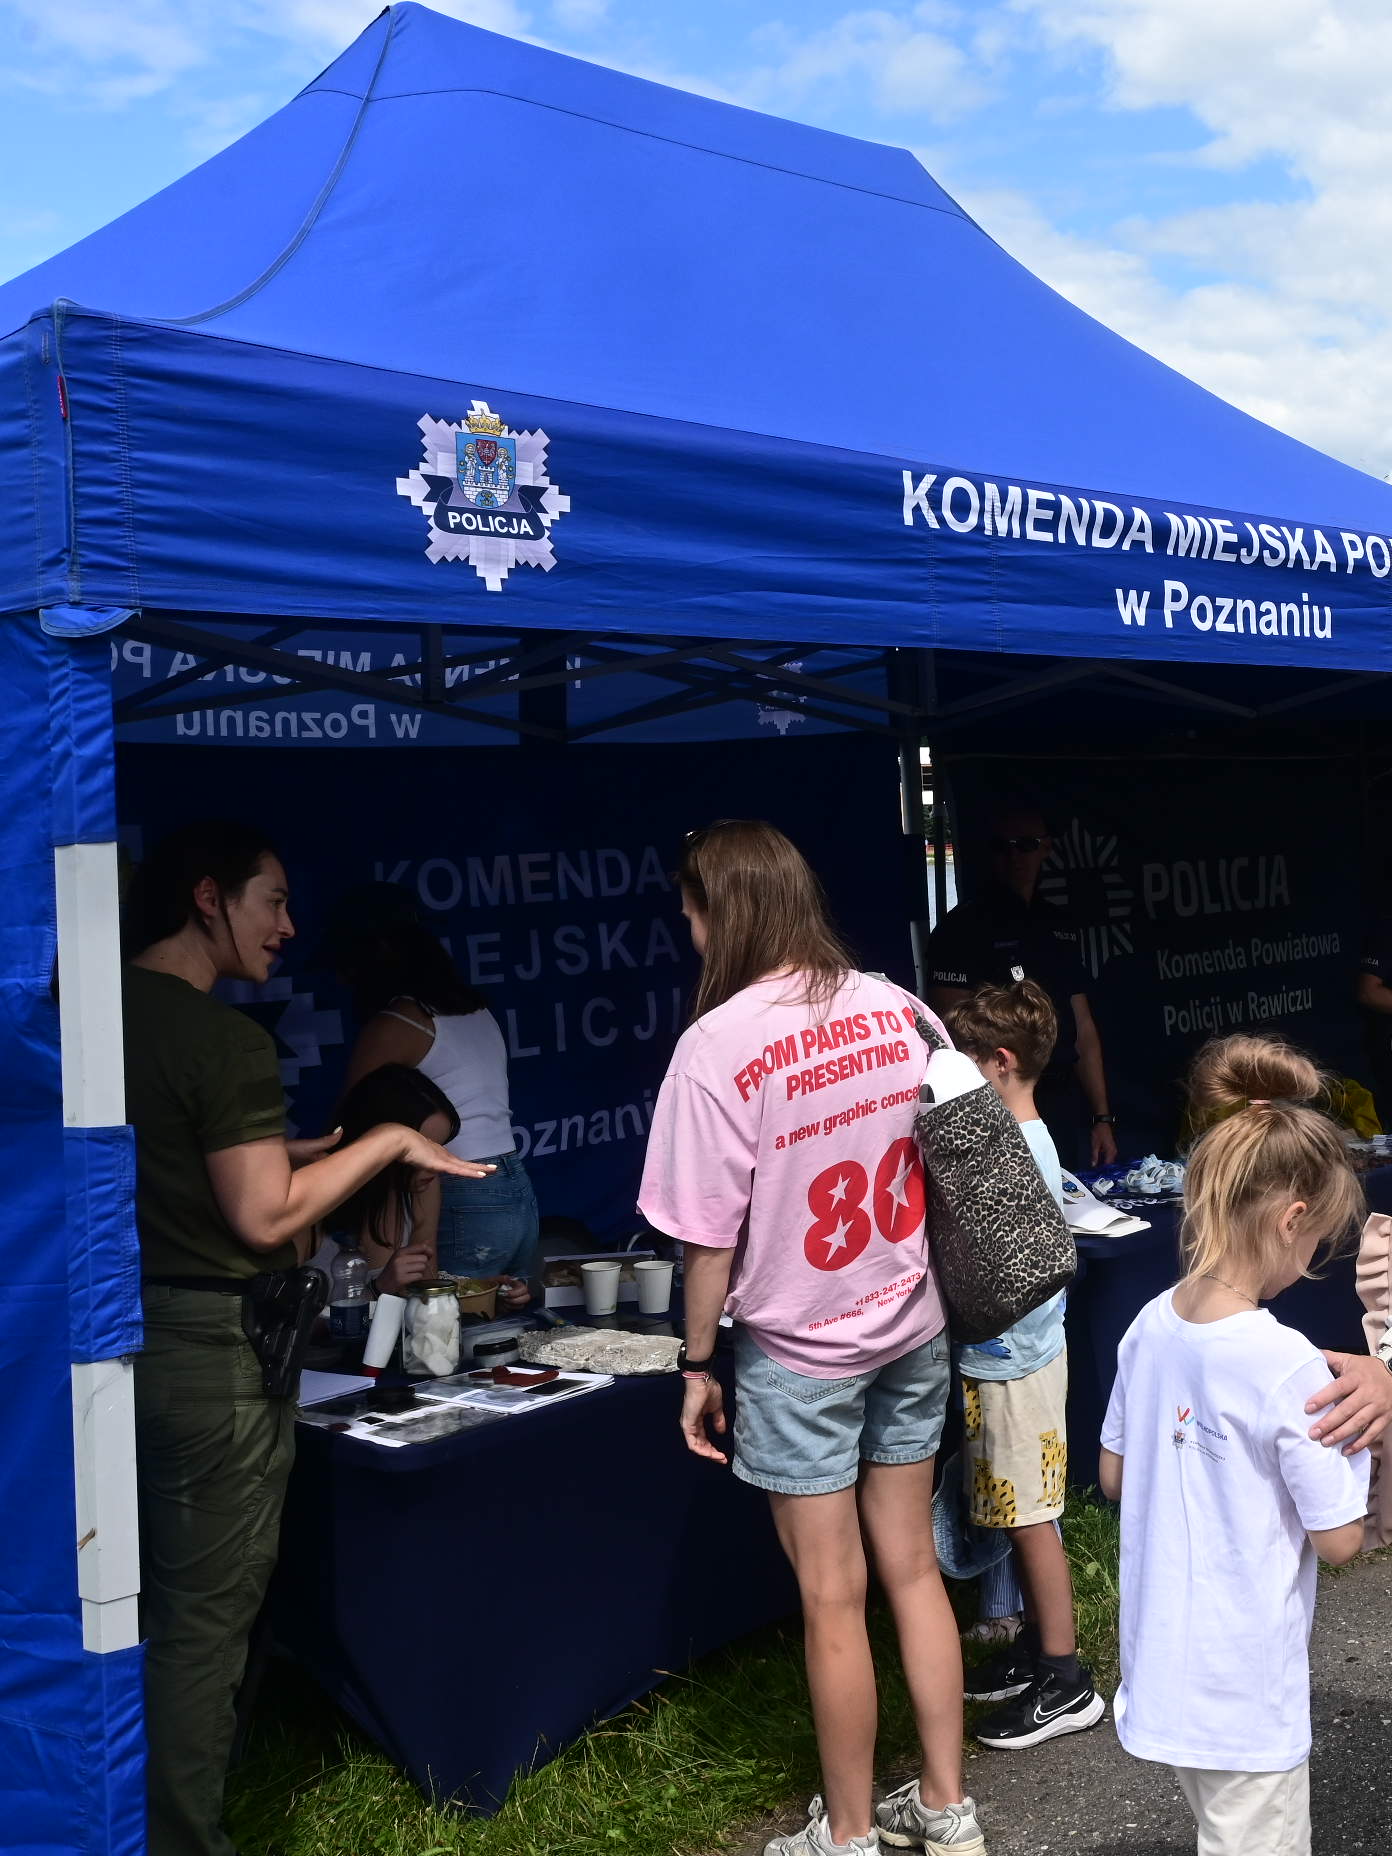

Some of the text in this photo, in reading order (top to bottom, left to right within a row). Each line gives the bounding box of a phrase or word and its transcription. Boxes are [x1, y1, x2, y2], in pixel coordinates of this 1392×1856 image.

[447, 511, 535, 536] POLICJA
[902, 470, 1153, 553] KOMENDA
[1165, 512, 1336, 572] MIEJSKA
[1115, 579, 1333, 639] w Poznaniu
[373, 845, 672, 911] KOMENDA
[1142, 853, 1292, 921] POLICJA
[440, 916, 681, 985] EJSKA
[932, 970, 968, 983] POLICJA
[1156, 931, 1341, 980] Komenda Powiatowa
[506, 987, 681, 1059] LICJI
[1164, 983, 1313, 1036] Policji w Rawiczu
[734, 1034, 799, 1103] FROM
[800, 1013, 872, 1060] PARIS
[871, 1011, 903, 1035] TO
[786, 1040, 910, 1101] PRESENTING
[775, 1135, 786, 1150] a
[789, 1121, 820, 1146] new
[824, 1098, 878, 1136] graphic
[804, 1136, 927, 1271] 80
[808, 1321, 822, 1332] 5th
[823, 1316, 839, 1326] Ave
[877, 1296, 895, 1308] New
